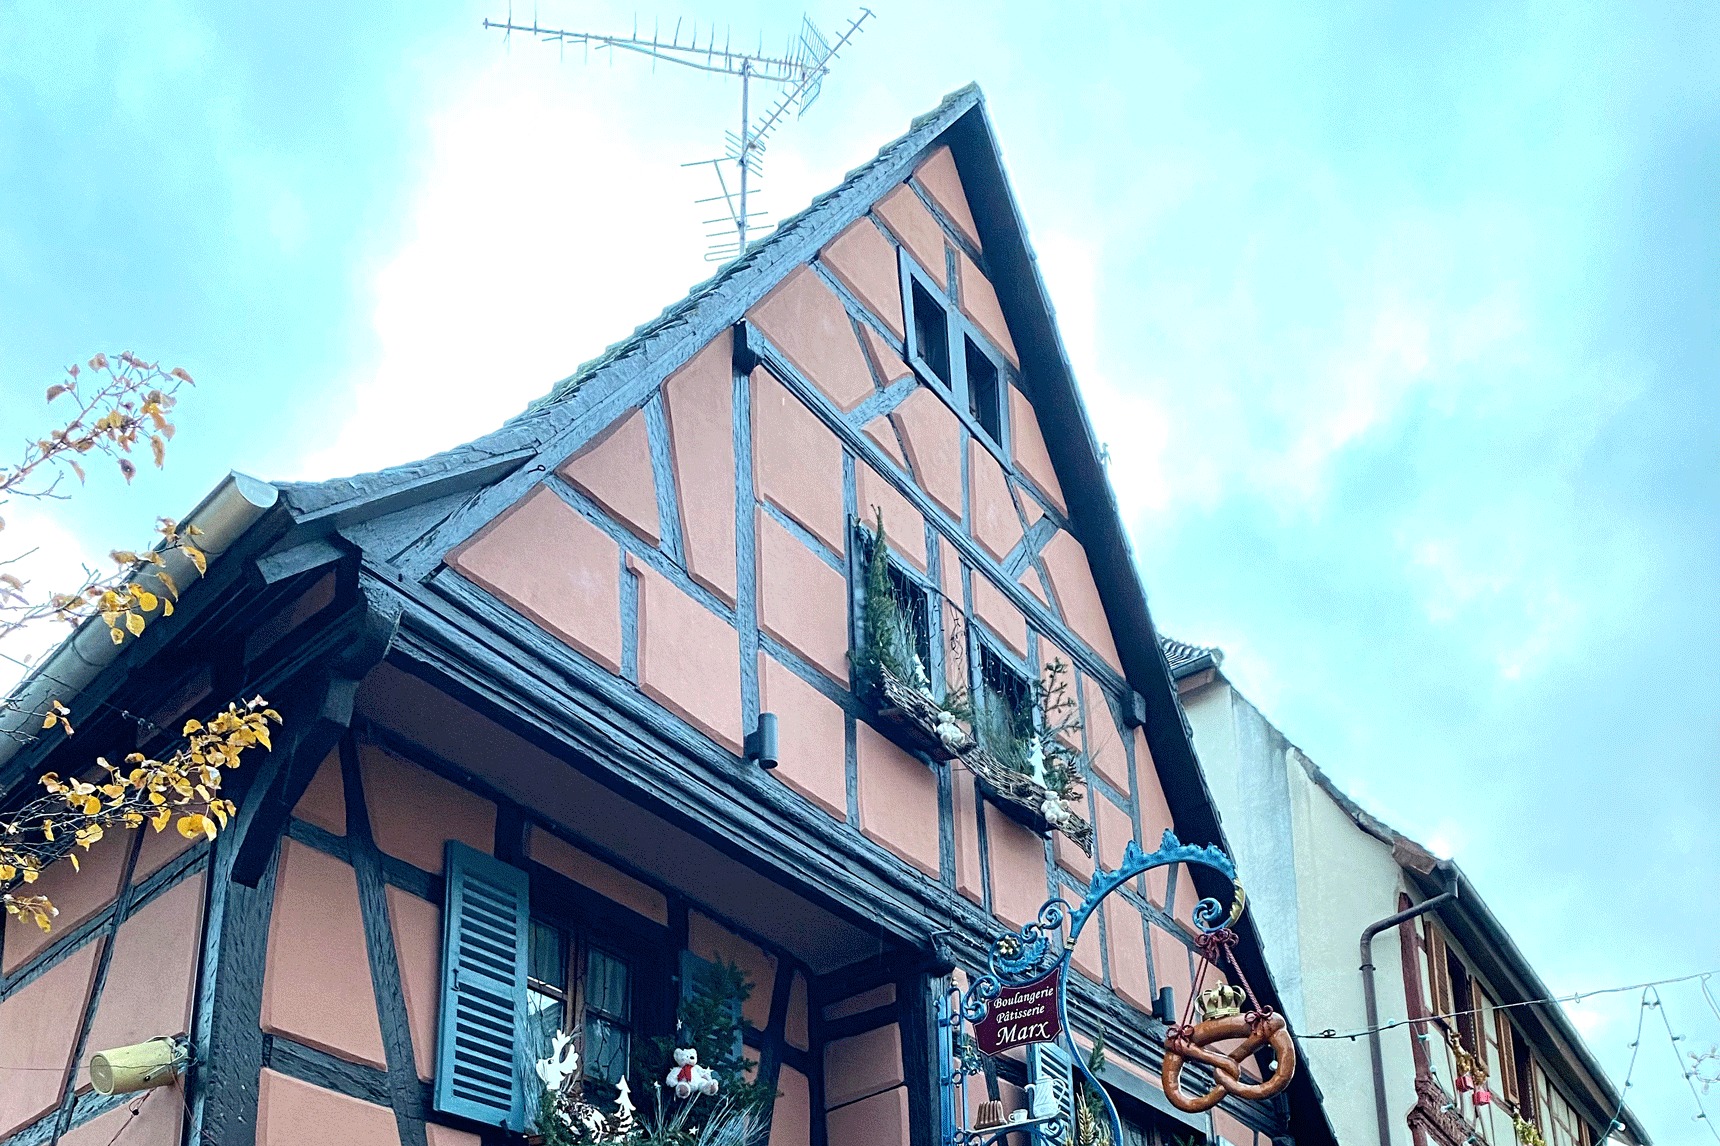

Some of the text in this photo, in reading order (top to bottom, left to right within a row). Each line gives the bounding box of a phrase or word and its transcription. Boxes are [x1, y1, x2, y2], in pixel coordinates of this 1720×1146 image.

[993, 986, 1054, 1009] Boulangerie
[996, 1004, 1046, 1024] Pâtisserie
[995, 1021, 1051, 1046] Marx
